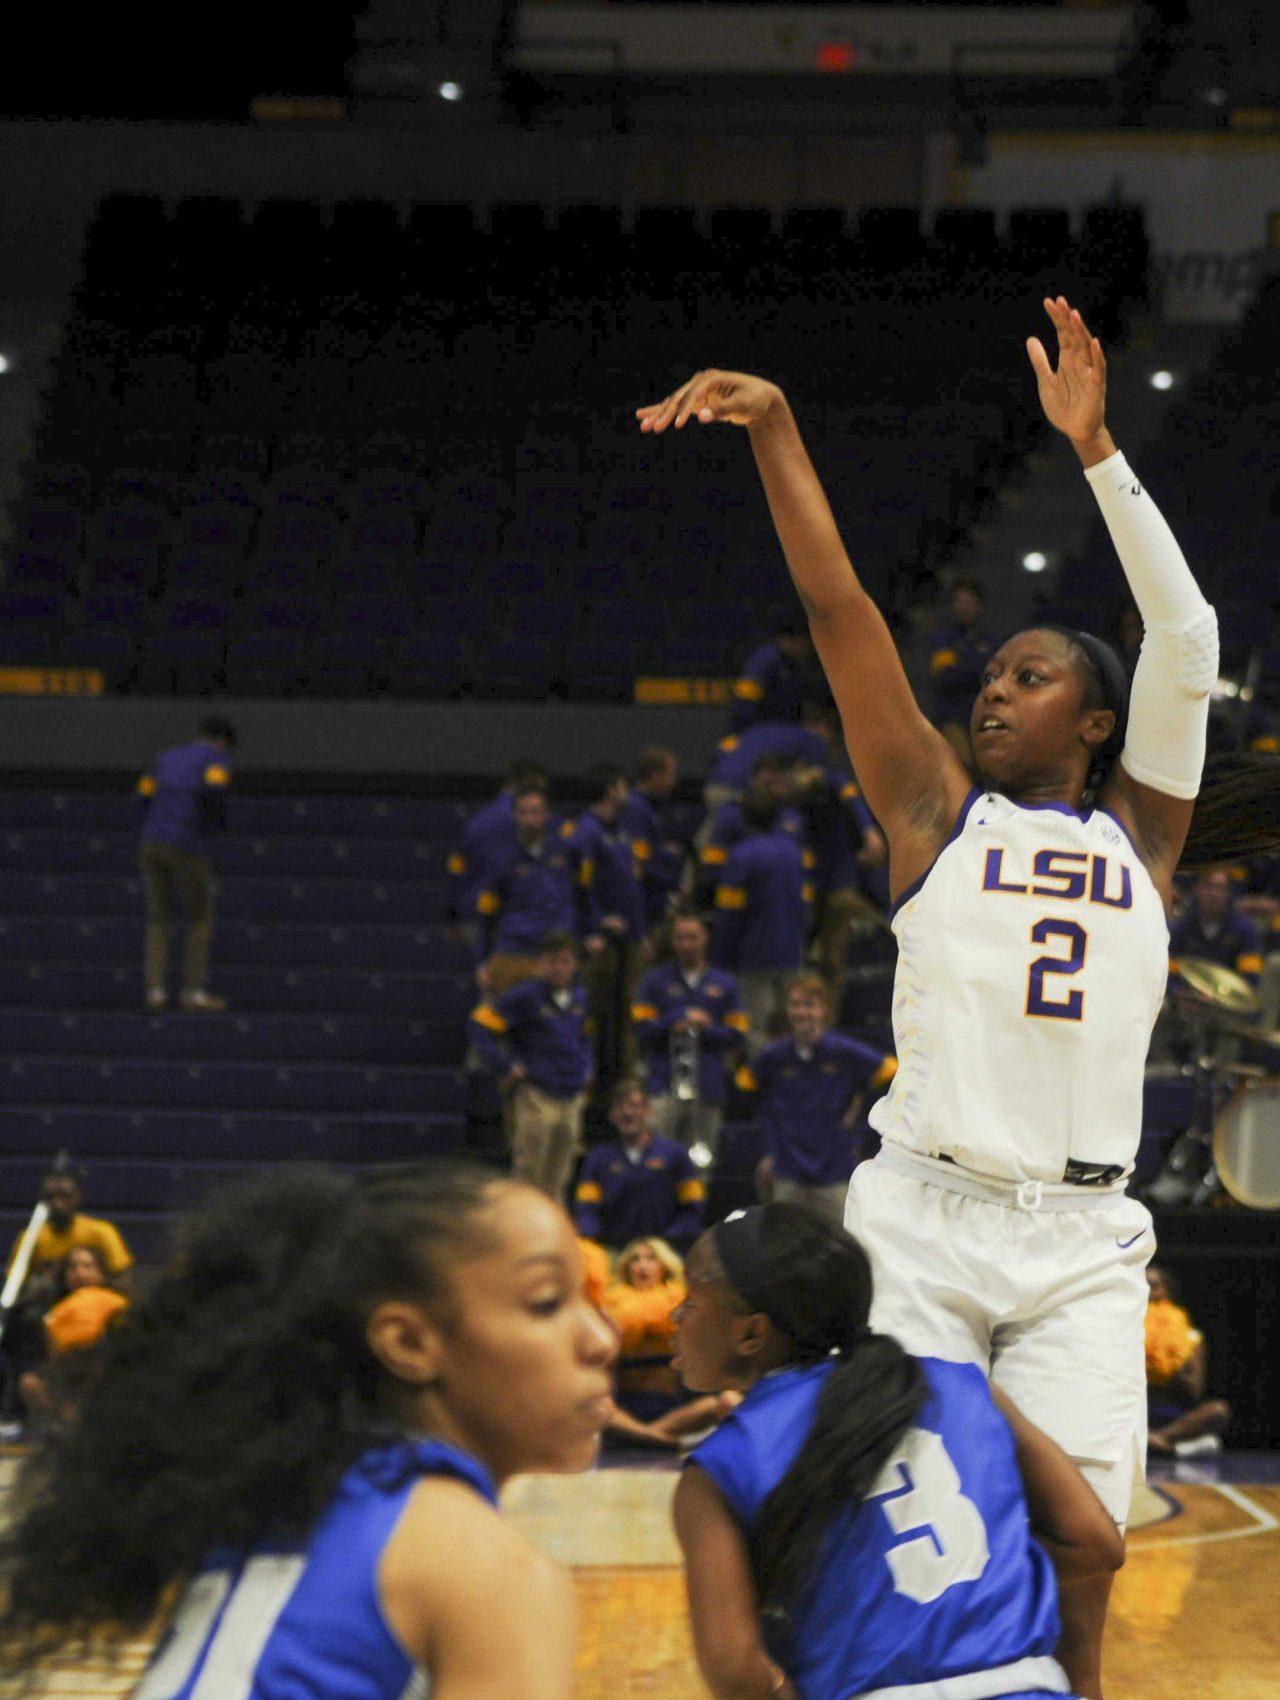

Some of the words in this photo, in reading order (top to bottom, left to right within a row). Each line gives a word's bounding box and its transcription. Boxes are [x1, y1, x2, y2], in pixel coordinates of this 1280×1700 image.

[981, 847, 1133, 910] LSU
[1023, 916, 1089, 1023] 2
[865, 1427, 992, 1606] 3
